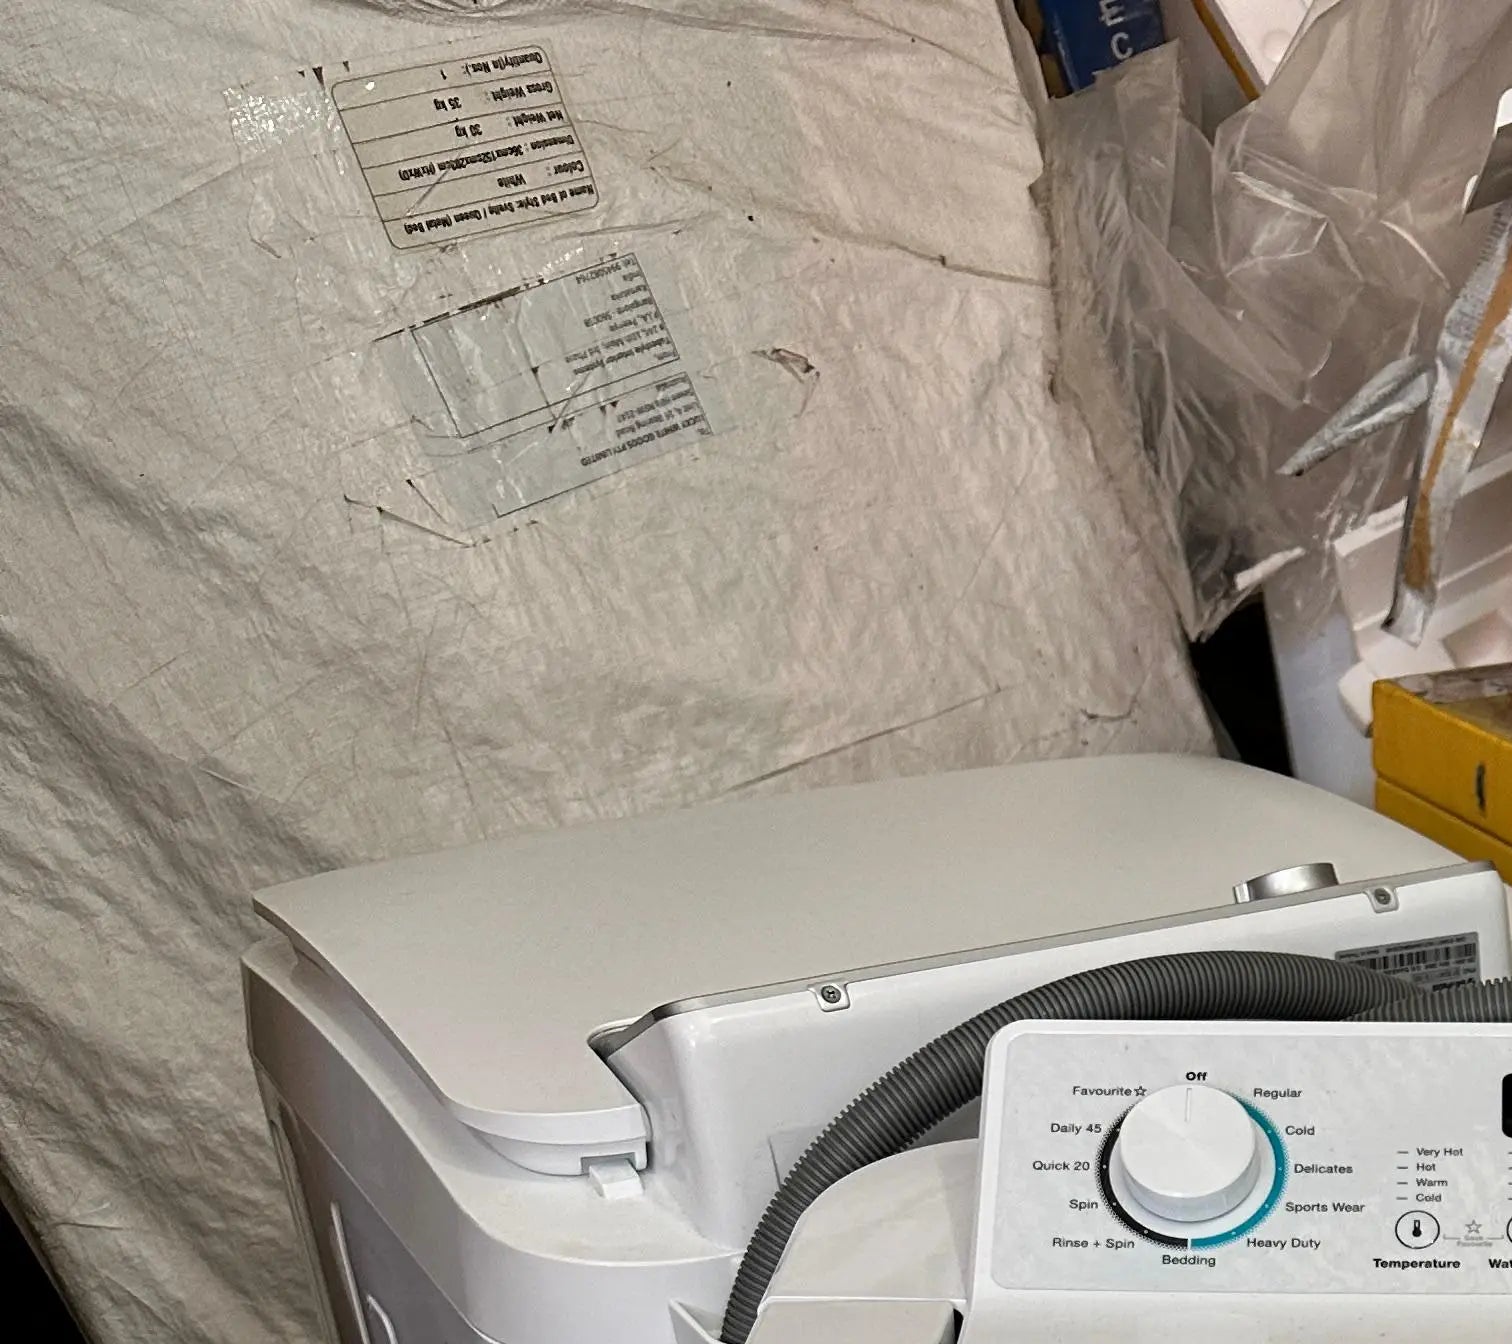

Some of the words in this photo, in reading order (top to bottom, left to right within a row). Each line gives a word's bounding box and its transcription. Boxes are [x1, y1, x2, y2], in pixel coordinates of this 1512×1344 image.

[446, 95, 462, 109] 35
[1185, 1072, 1207, 1080] Off
[1073, 1087, 1132, 1096] Favourite
[1253, 1088, 1302, 1099] Regular
[1050, 1123, 1083, 1135] Daily
[1086, 1124, 1102, 1133] 45
[1285, 1126, 1315, 1136] Cold
[1416, 1147, 1440, 1158] Very
[1445, 1147, 1464, 1156] Hot
[1032, 1160, 1067, 1171] Quick
[1073, 1161, 1090, 1170] 20
[1294, 1164, 1353, 1174] Delicates
[1416, 1163, 1436, 1172] Hot
[1416, 1178, 1448, 1187] Warm
[1416, 1194, 1442, 1202] Cold
[1069, 1199, 1098, 1212] Spin
[1285, 1202, 1328, 1213] Sports
[1332, 1202, 1365, 1212] Wear
[1052, 1238, 1088, 1248] Rinse
[1106, 1239, 1135, 1251] Spin
[1247, 1238, 1284, 1251] Heavy
[1289, 1238, 1321, 1251] Duty
[1162, 1255, 1216, 1268] Bedding
[1373, 1259, 1460, 1271] Temperature
